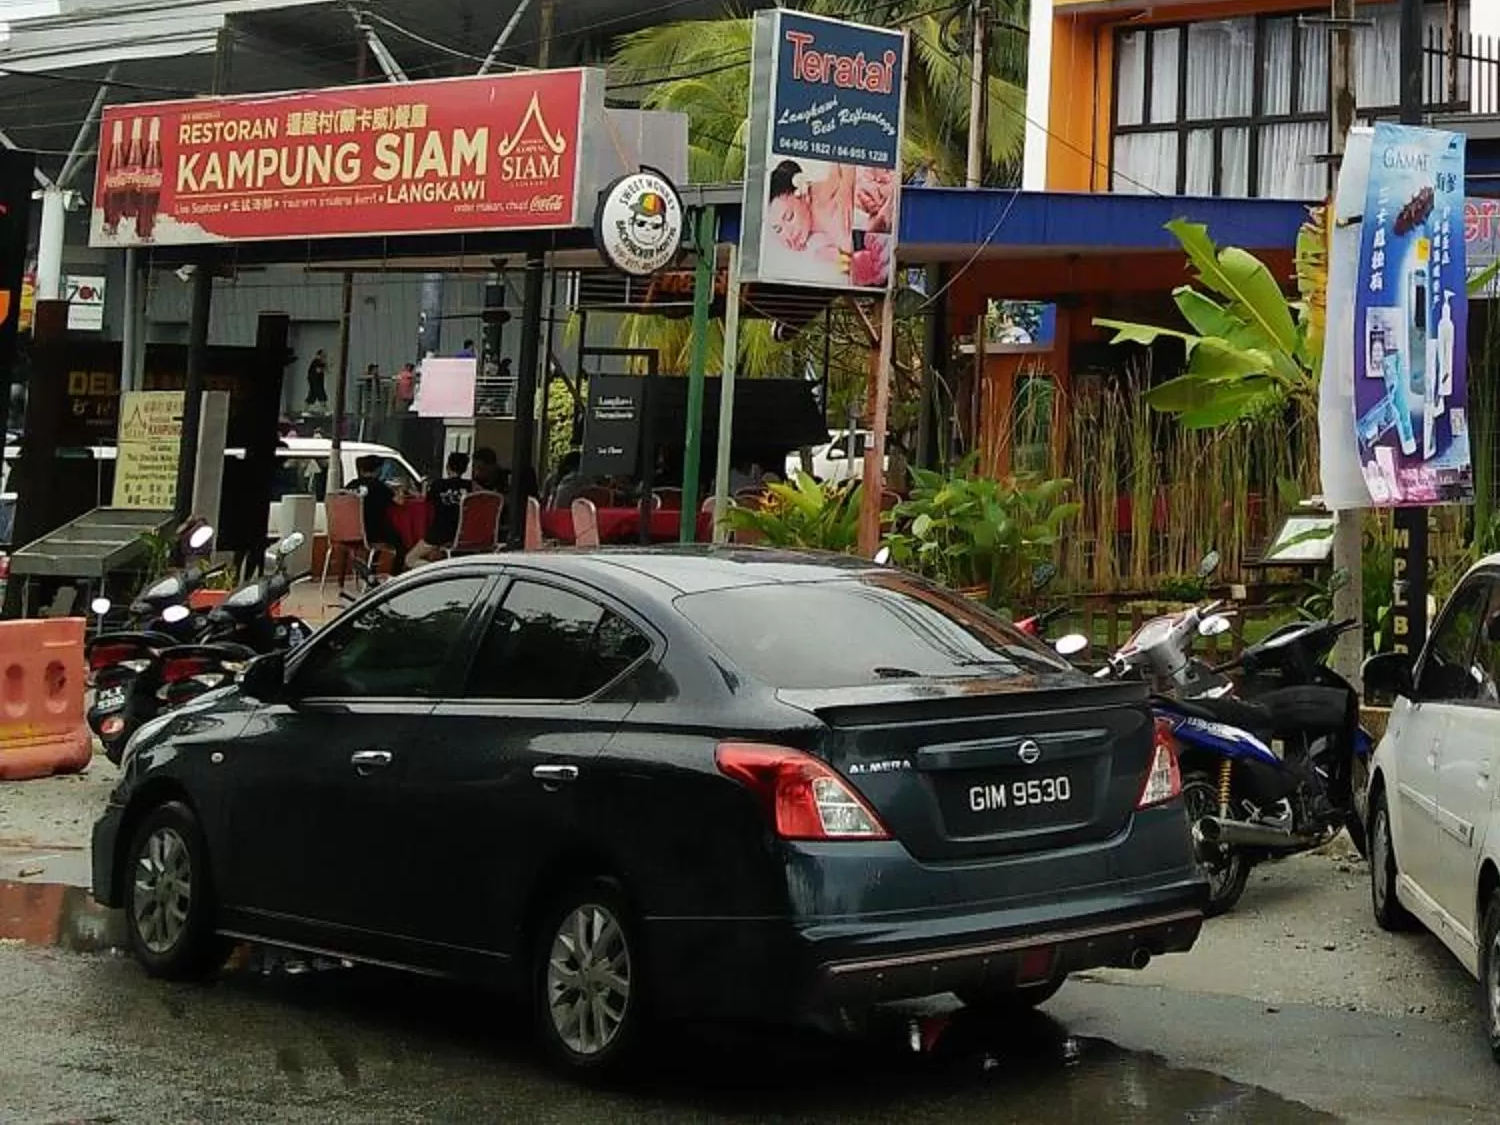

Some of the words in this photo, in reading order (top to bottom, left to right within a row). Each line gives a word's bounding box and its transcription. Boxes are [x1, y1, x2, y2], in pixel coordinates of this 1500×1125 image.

[785, 30, 898, 95] Teratai
[178, 116, 279, 146] RESTORAN
[176, 141, 361, 193] KAMPUNG
[373, 126, 490, 183] SIAM
[501, 154, 561, 182] SIAM
[386, 179, 486, 205] LANGKAWI
[849, 759, 911, 774] ALMERA
[1012, 776, 1071, 806] 9530
